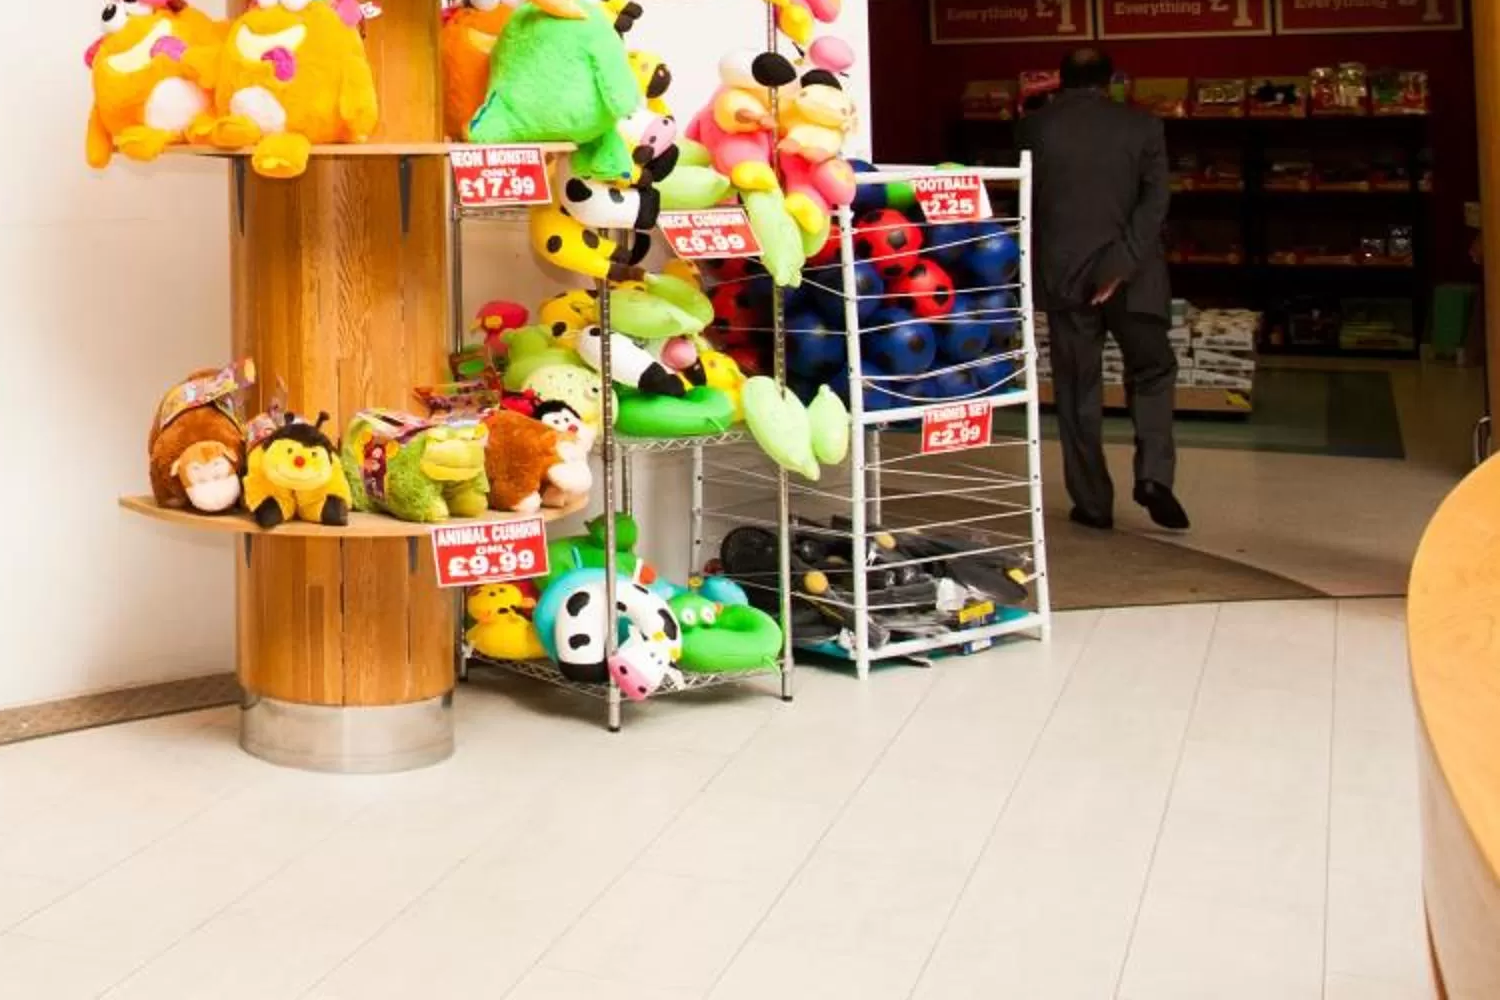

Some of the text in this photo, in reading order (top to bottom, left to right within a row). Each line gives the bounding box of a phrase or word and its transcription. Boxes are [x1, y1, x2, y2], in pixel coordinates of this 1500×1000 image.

[459, 177, 536, 198] £17.99
[912, 175, 979, 192] FOOTBALL
[437, 526, 489, 547] ANIMAL
[475, 543, 515, 555] ONLY
[448, 549, 536, 577] £9.99
